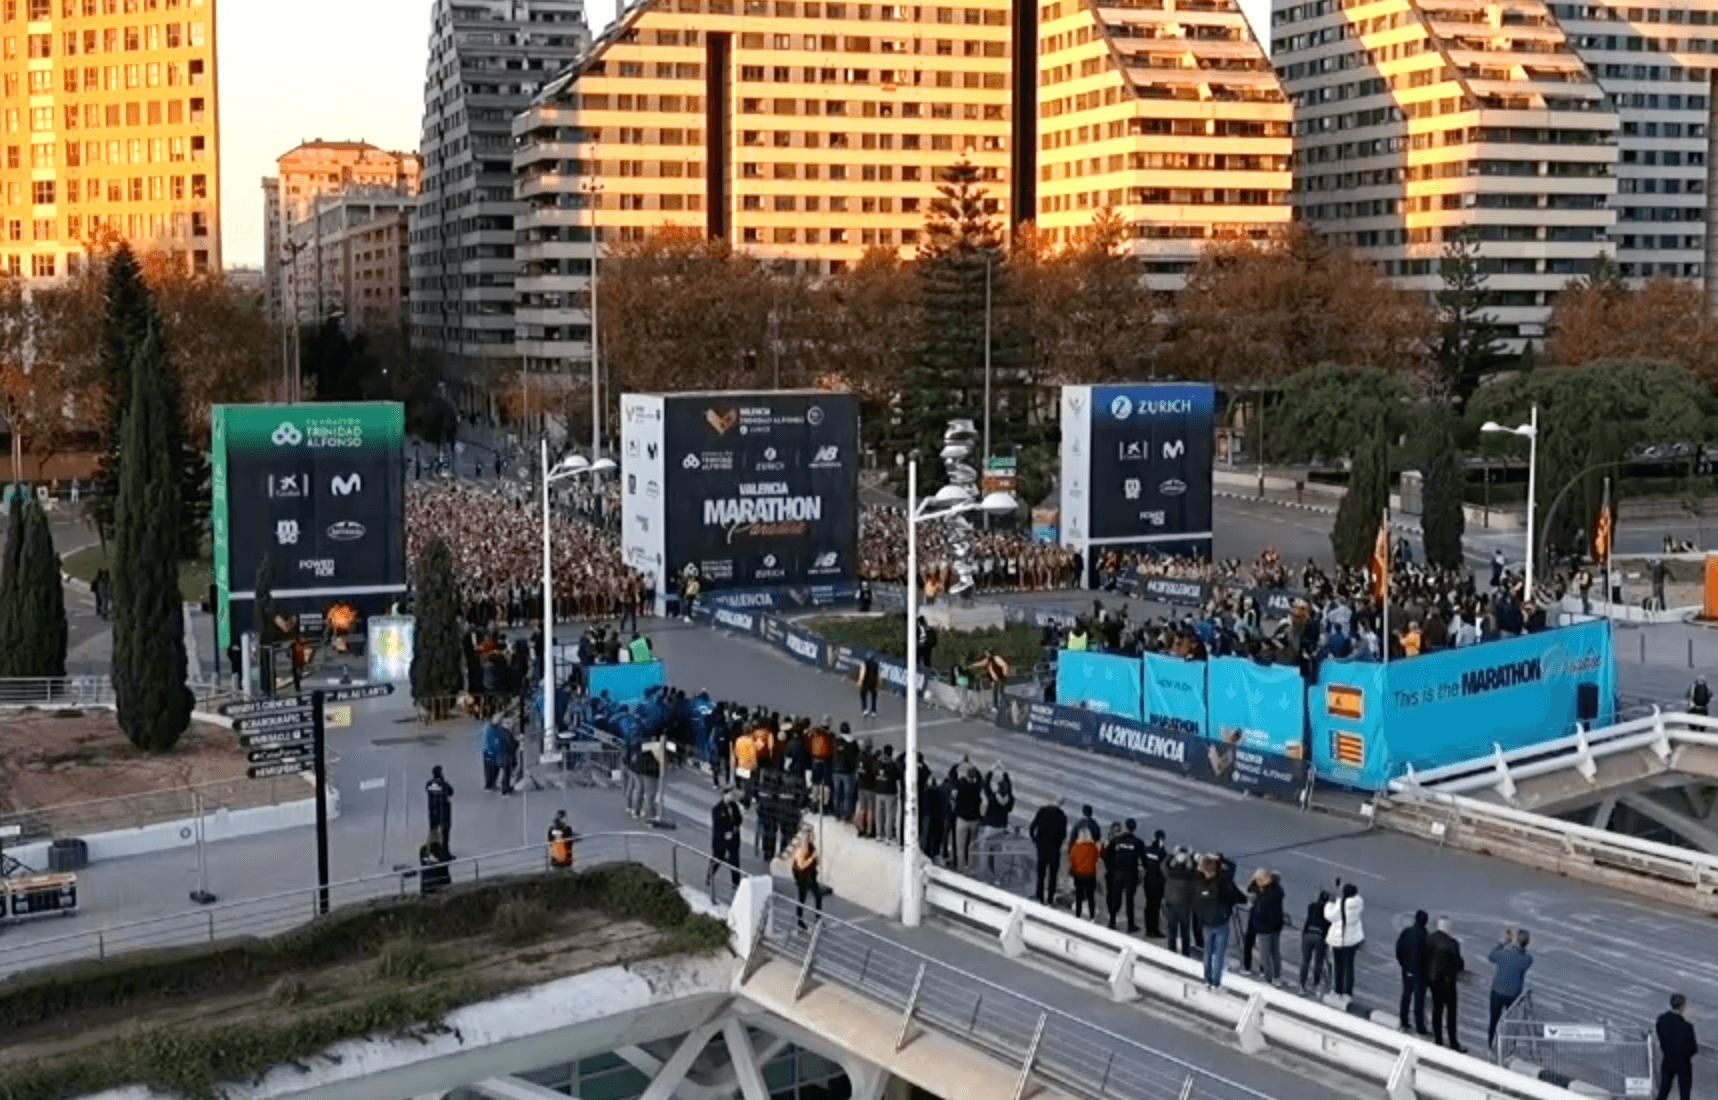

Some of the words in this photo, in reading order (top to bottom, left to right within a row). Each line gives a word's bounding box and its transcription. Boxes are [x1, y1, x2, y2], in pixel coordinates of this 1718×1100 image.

[1138, 399, 1192, 415] ZURICH
[307, 425, 363, 436] TRINIDAD
[307, 437, 363, 447] ALFONSO
[739, 482, 788, 495] VALENCIA
[704, 496, 821, 525] MARATHON
[1394, 689, 1419, 708] This
[1423, 687, 1434, 703] is
[1438, 680, 1460, 698] the
[1462, 657, 1542, 697] MARATHON
[1099, 722, 1185, 763] #42KVALENCIA
